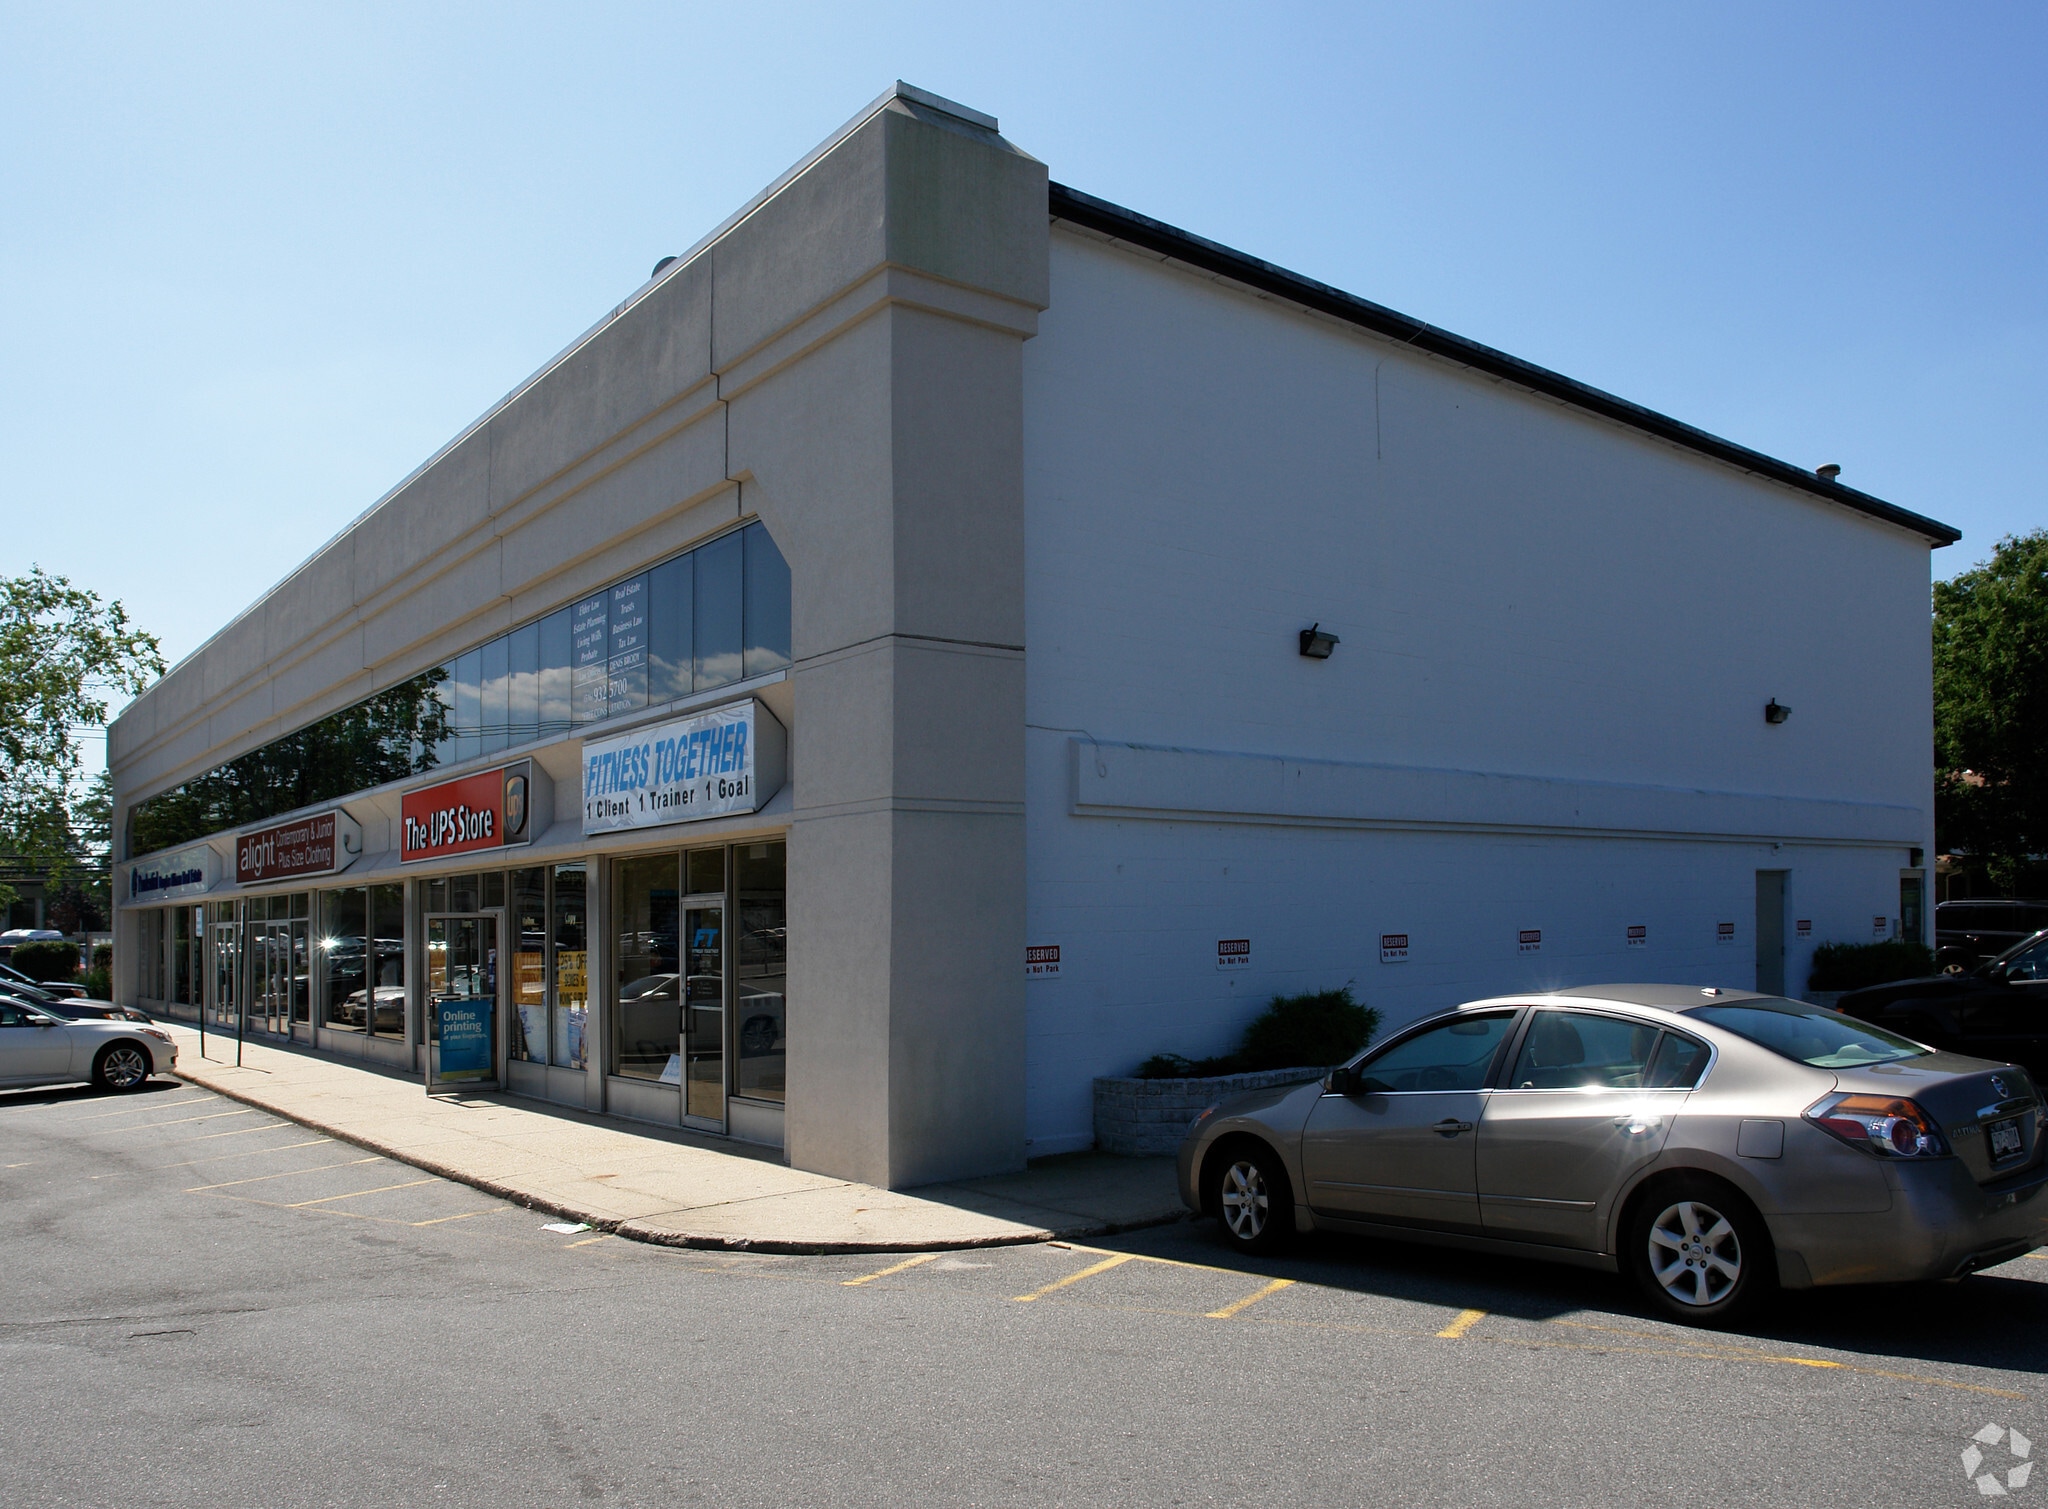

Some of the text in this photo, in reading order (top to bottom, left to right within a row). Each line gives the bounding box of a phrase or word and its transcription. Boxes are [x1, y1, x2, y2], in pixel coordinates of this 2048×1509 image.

[615, 582, 641, 600] Real Estate
[591, 601, 600, 611] Law
[573, 622, 587, 634] Estate
[633, 616, 643, 627] Law
[627, 635, 637, 646] Law
[581, 649, 598, 662] Probate
[609, 677, 628, 698] 5700
[586, 721, 748, 798] FITNESS TOGETHER
[586, 775, 749, 819] 1 Client 1 Trainer 1 Goal
[275, 825, 310, 848] Contemporary
[316, 819, 334, 839] Junior
[405, 804, 494, 851] The UPS Store
[240, 836, 275, 876] alight
[278, 845, 331, 870] Plus Size Clothing
[693, 928, 719, 947] FT
[1383, 936, 1407, 947] RESERVED
[1219, 941, 1249, 954] RESERVED
[1026, 948, 1058, 961] ESERVED
[1219, 956, 1249, 965] Do Not Park
[560, 953, 573, 970] 25%
[1033, 965, 1043, 974] Not
[1046, 963, 1060, 973] Park
[443, 1011, 476, 1021] Online
[443, 1022, 482, 1035] printing
